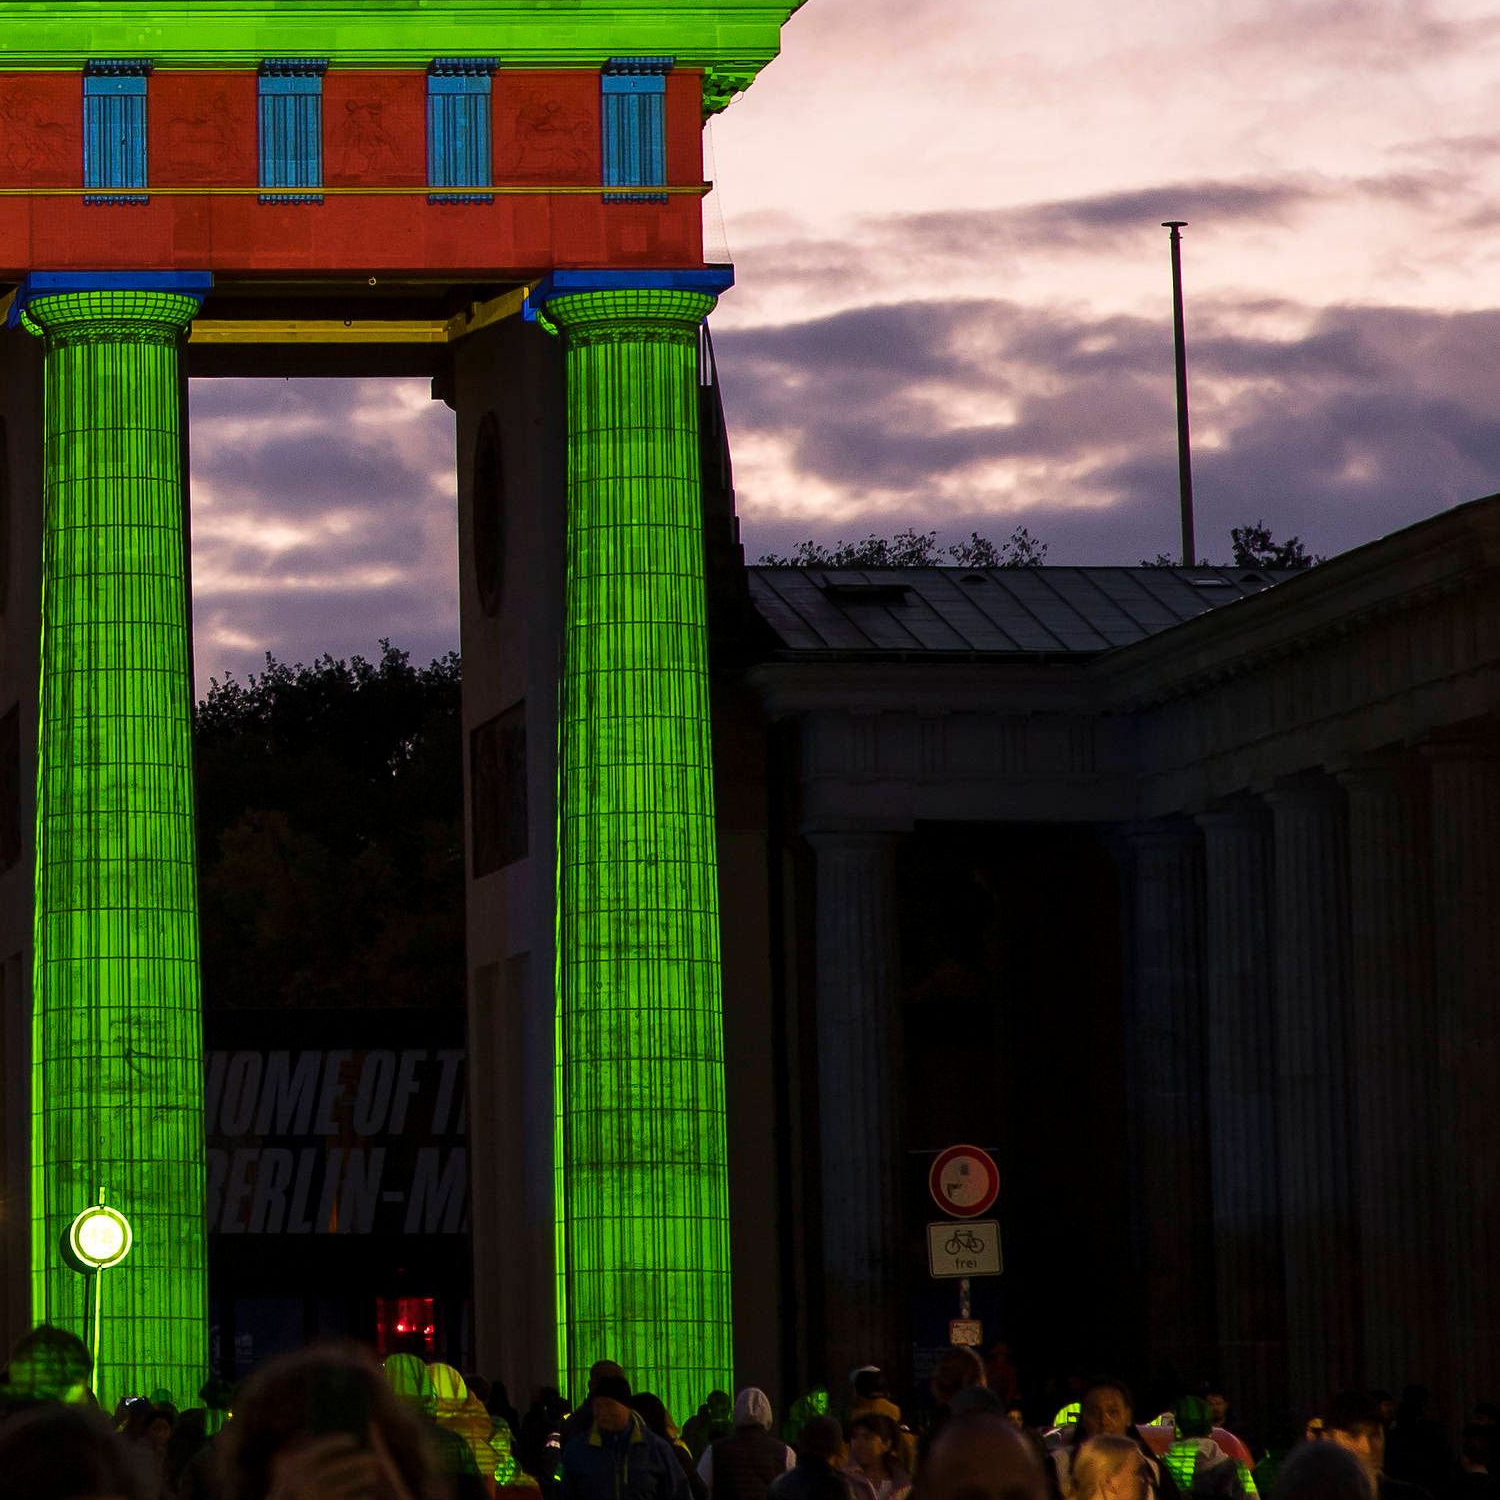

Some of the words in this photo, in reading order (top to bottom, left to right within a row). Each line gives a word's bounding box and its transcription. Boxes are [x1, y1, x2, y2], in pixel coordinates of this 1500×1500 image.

[353, 1049, 428, 1136] OF
[430, 1049, 466, 1136] T
[207, 1148, 471, 1234] BERLIN-M
[955, 1257, 977, 1269] frei
